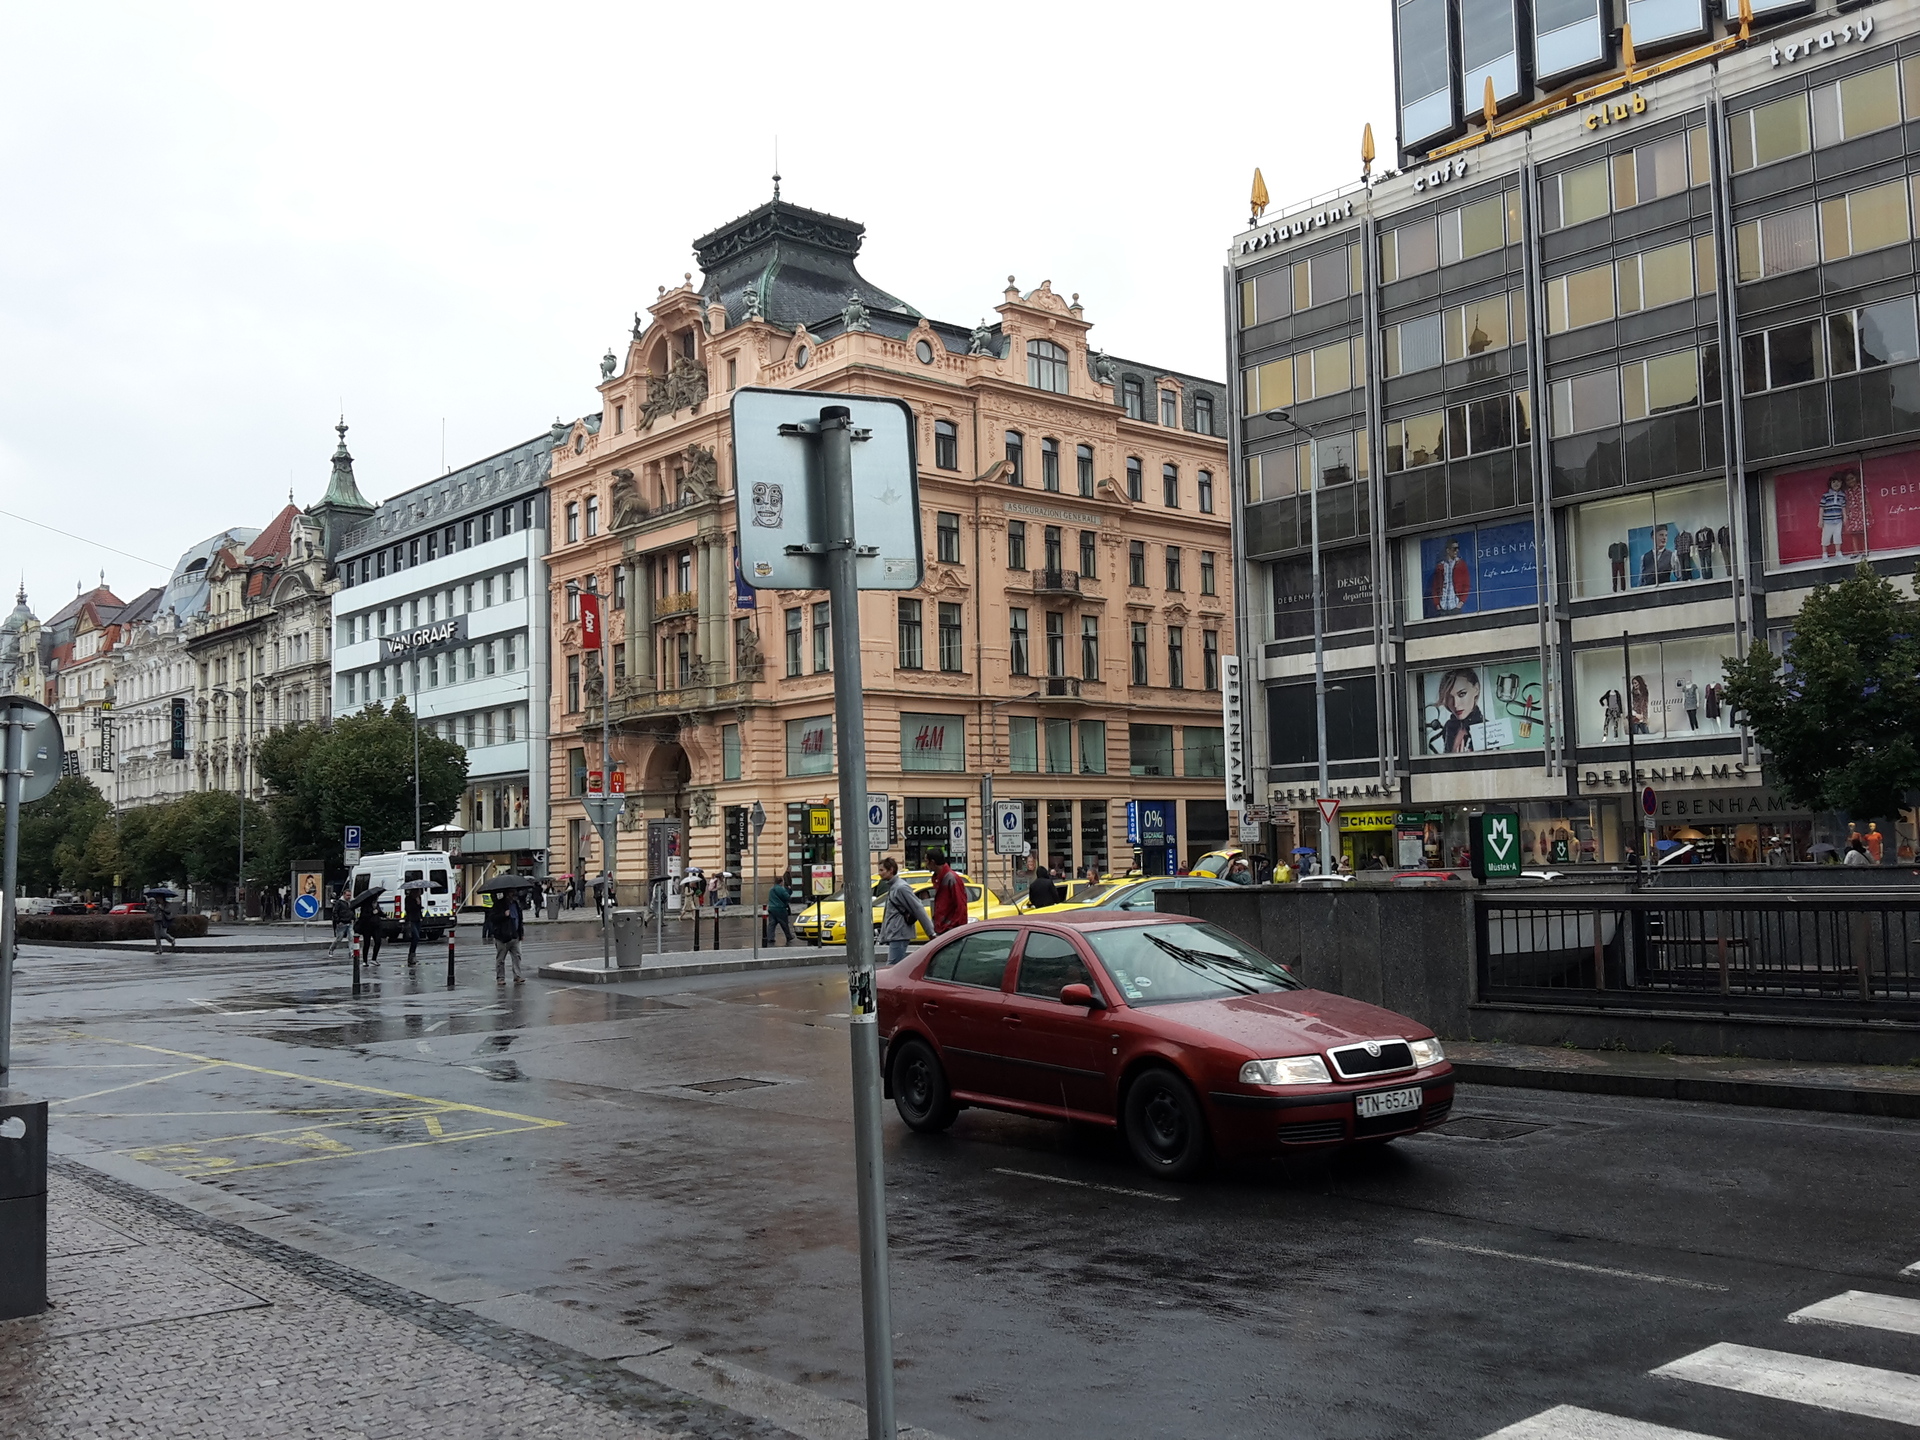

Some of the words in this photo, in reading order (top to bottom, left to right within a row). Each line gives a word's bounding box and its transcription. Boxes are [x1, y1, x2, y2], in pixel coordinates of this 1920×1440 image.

[1768, 16, 1876, 68] terasy
[1585, 93, 1647, 131] club
[1414, 157, 1468, 192] café
[1240, 199, 1353, 255] restaurant
[1880, 482, 1920, 498] DEBE
[387, 634, 411, 653] VAN
[412, 621, 456, 646] GRAAF
[173, 706, 183, 749] GATE
[800, 727, 823, 754] H&M
[915, 725, 945, 751] H&M
[1227, 664, 1243, 803] DEBENHAMS
[102, 719, 111, 771] McDonald's
[1585, 762, 1748, 787] DEBENHAMS
[1661, 795, 1804, 816] EBENHAM
[813, 816, 827, 826] TAXI
[907, 825, 948, 836] SEPHOR
[1144, 810, 1163, 828] 0%
[348, 829, 358, 842] P
[1364, 1088, 1421, 1113] TN-652AV
